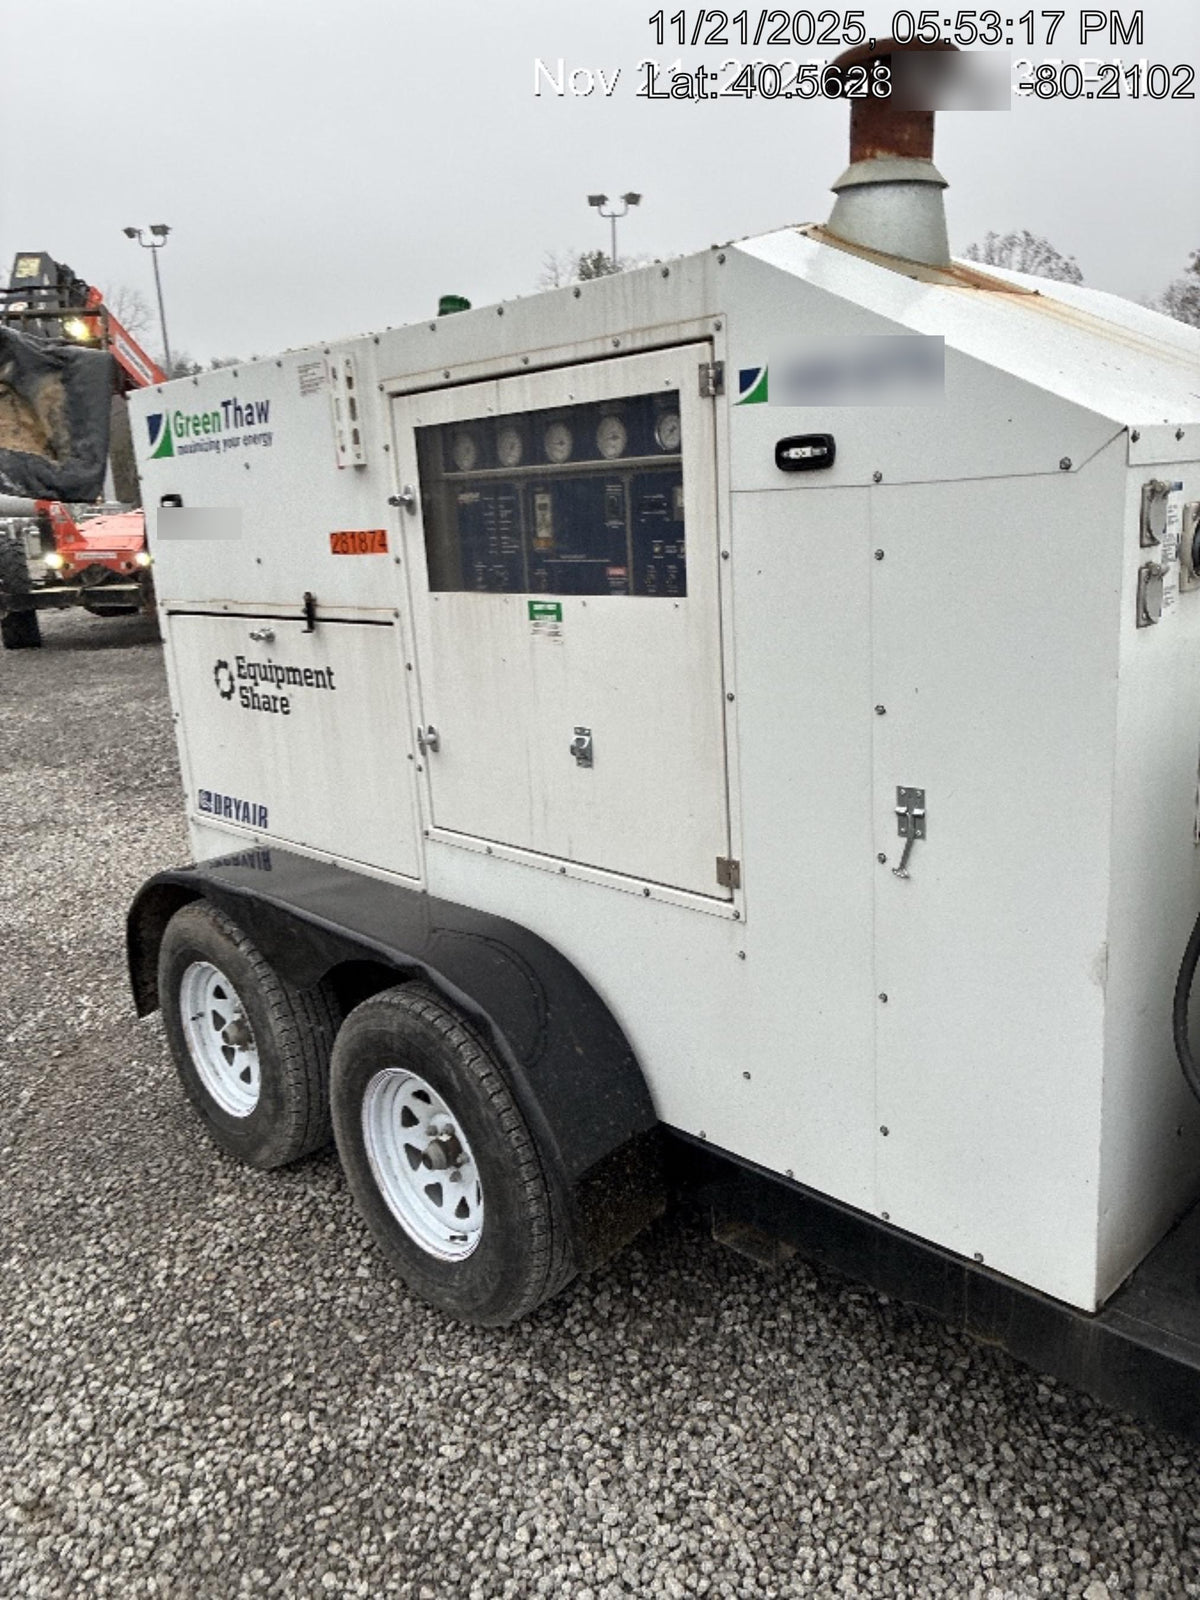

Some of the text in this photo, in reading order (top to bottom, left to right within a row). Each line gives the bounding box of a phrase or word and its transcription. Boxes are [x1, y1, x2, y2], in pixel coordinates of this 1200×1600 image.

[173, 397, 270, 438] GreenThaw
[177, 431, 273, 456] maximizing your energy
[330, 530, 388, 555] 281874
[235, 655, 336, 690] Equipment
[239, 686, 291, 715] Share
[214, 792, 268, 829] DRYAIR
